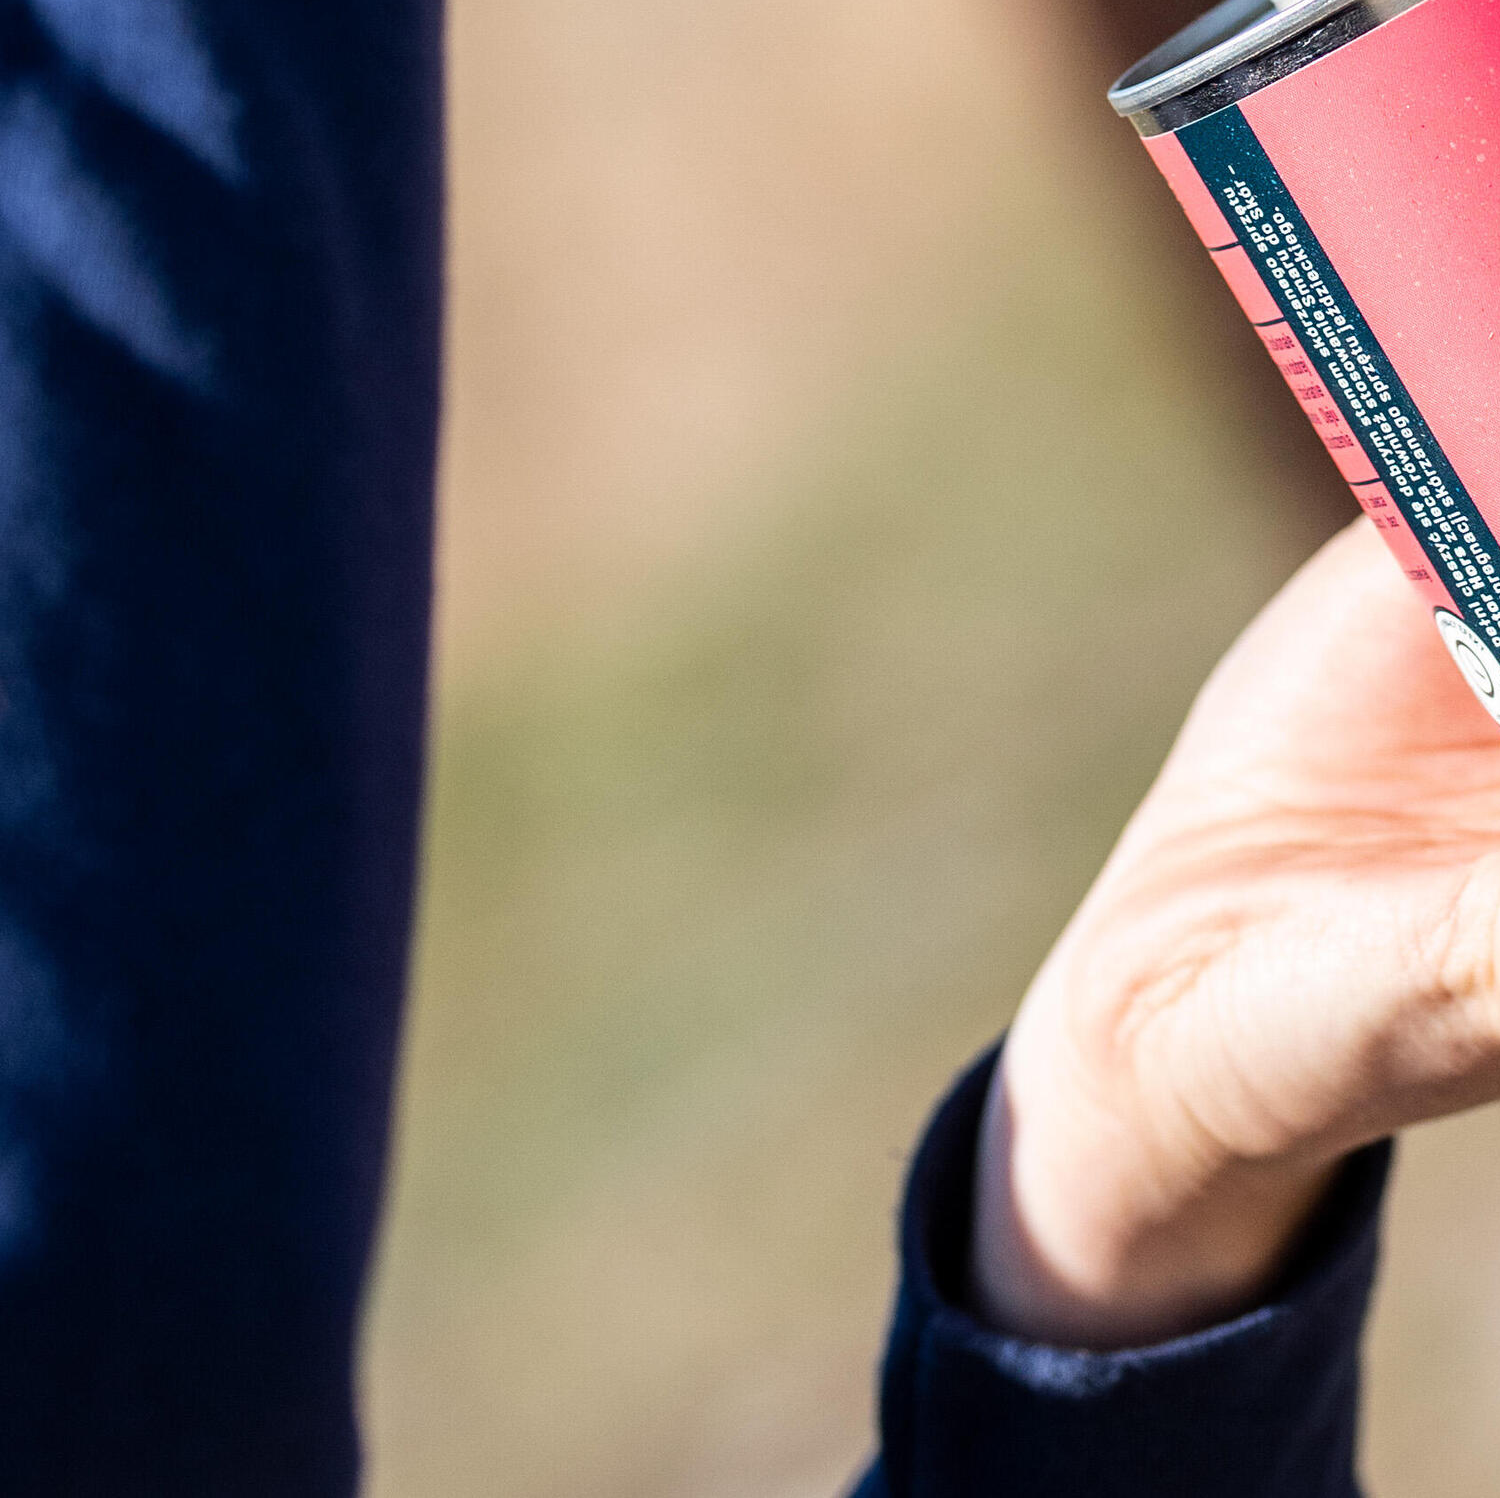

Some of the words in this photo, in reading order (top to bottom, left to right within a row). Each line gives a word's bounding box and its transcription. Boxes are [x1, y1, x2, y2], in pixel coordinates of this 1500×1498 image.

[1222, 186, 1268, 253] sprzętu
[1233, 179, 1264, 220] Skór
[1260, 222, 1280, 245] do
[1271, 205, 1355, 334] jeździeckiego.
[1275, 248, 1316, 307] Smaru
[1264, 256, 1331, 358] skórzanego
[1312, 309, 1378, 409] stosowanie
[1344, 334, 1392, 403] sprzętu
[1327, 360, 1372, 427] stanem
[1368, 429, 1414, 497] dobrym
[1371, 411, 1422, 482] również
[1387, 405, 1454, 508] skórzanego
[1410, 500, 1433, 528] się
[1417, 484, 1458, 543] zaleca
[1426, 530, 1474, 597] cieszyć
